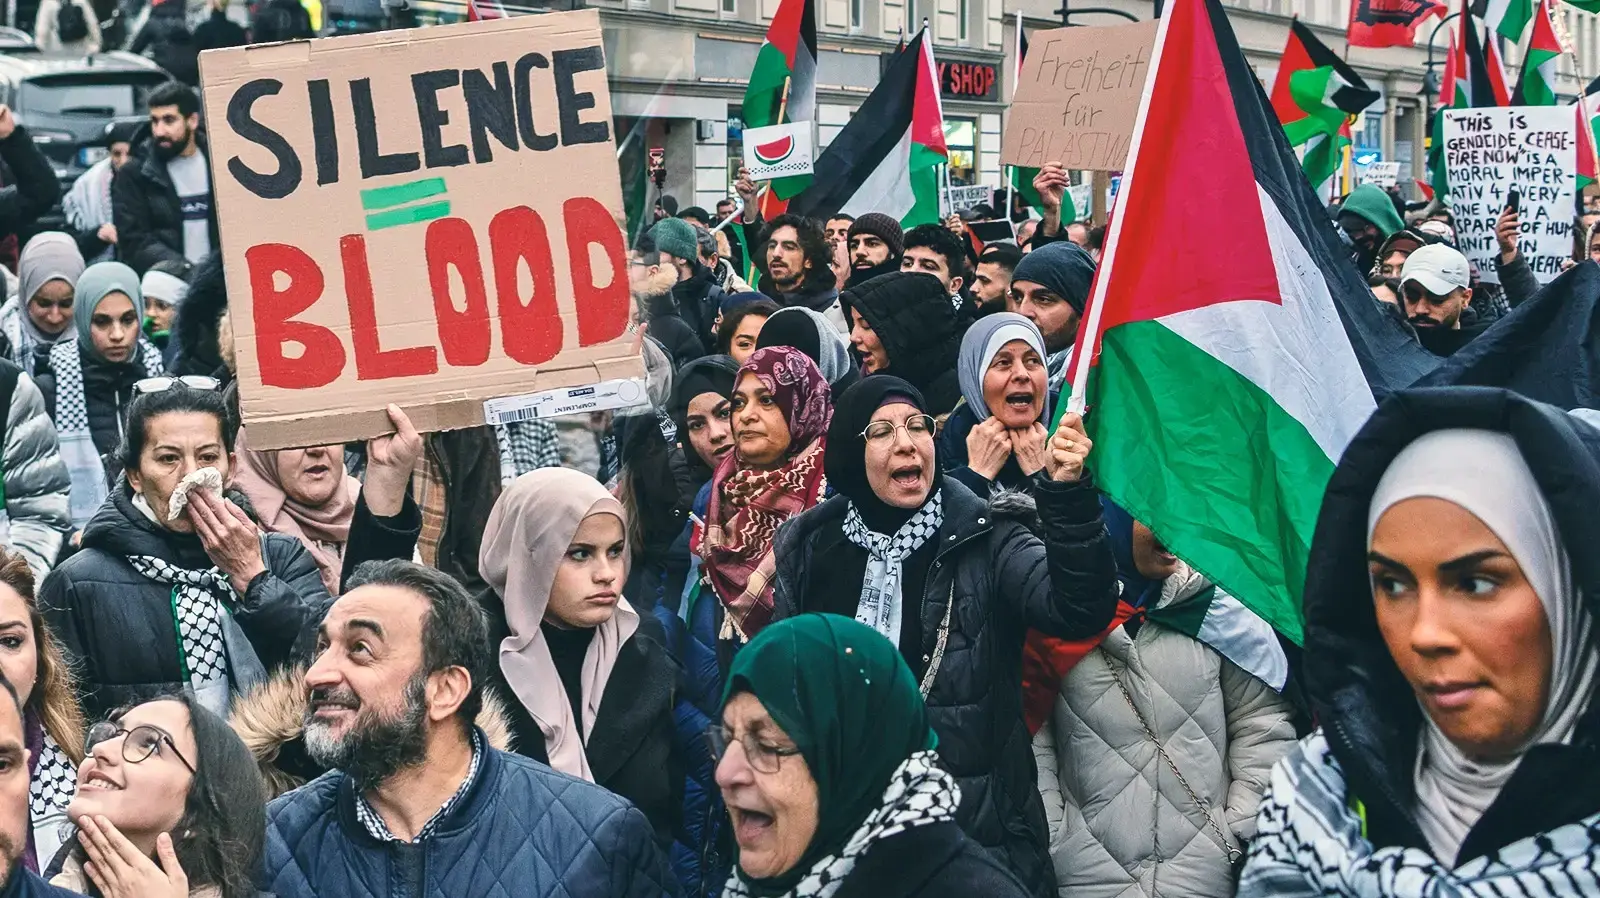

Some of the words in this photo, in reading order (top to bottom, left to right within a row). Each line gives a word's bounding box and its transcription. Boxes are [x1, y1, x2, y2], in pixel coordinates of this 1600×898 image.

[1036, 39, 1144, 92] Freiheit
[935, 62, 946, 93] Y
[950, 63, 995, 95] SHOP
[1062, 93, 1102, 127] für
[227, 45, 611, 199] SILENCE
[1447, 149, 1481, 166] FIRE
[1545, 153, 1558, 166] A
[1448, 166, 1504, 182] MORAL
[1451, 182, 1483, 200] ATIV
[1490, 183, 1504, 200] 4
[1453, 202, 1481, 216] ONE
[1487, 204, 1528, 218] WH
[1535, 205, 1550, 220] A
[1456, 218, 1497, 234] SPAR
[1520, 221, 1542, 236] OF
[1460, 232, 1494, 254] ANIT
[245, 197, 630, 389] BLOOD
[554, 402, 597, 413] KOMPLEMENT
